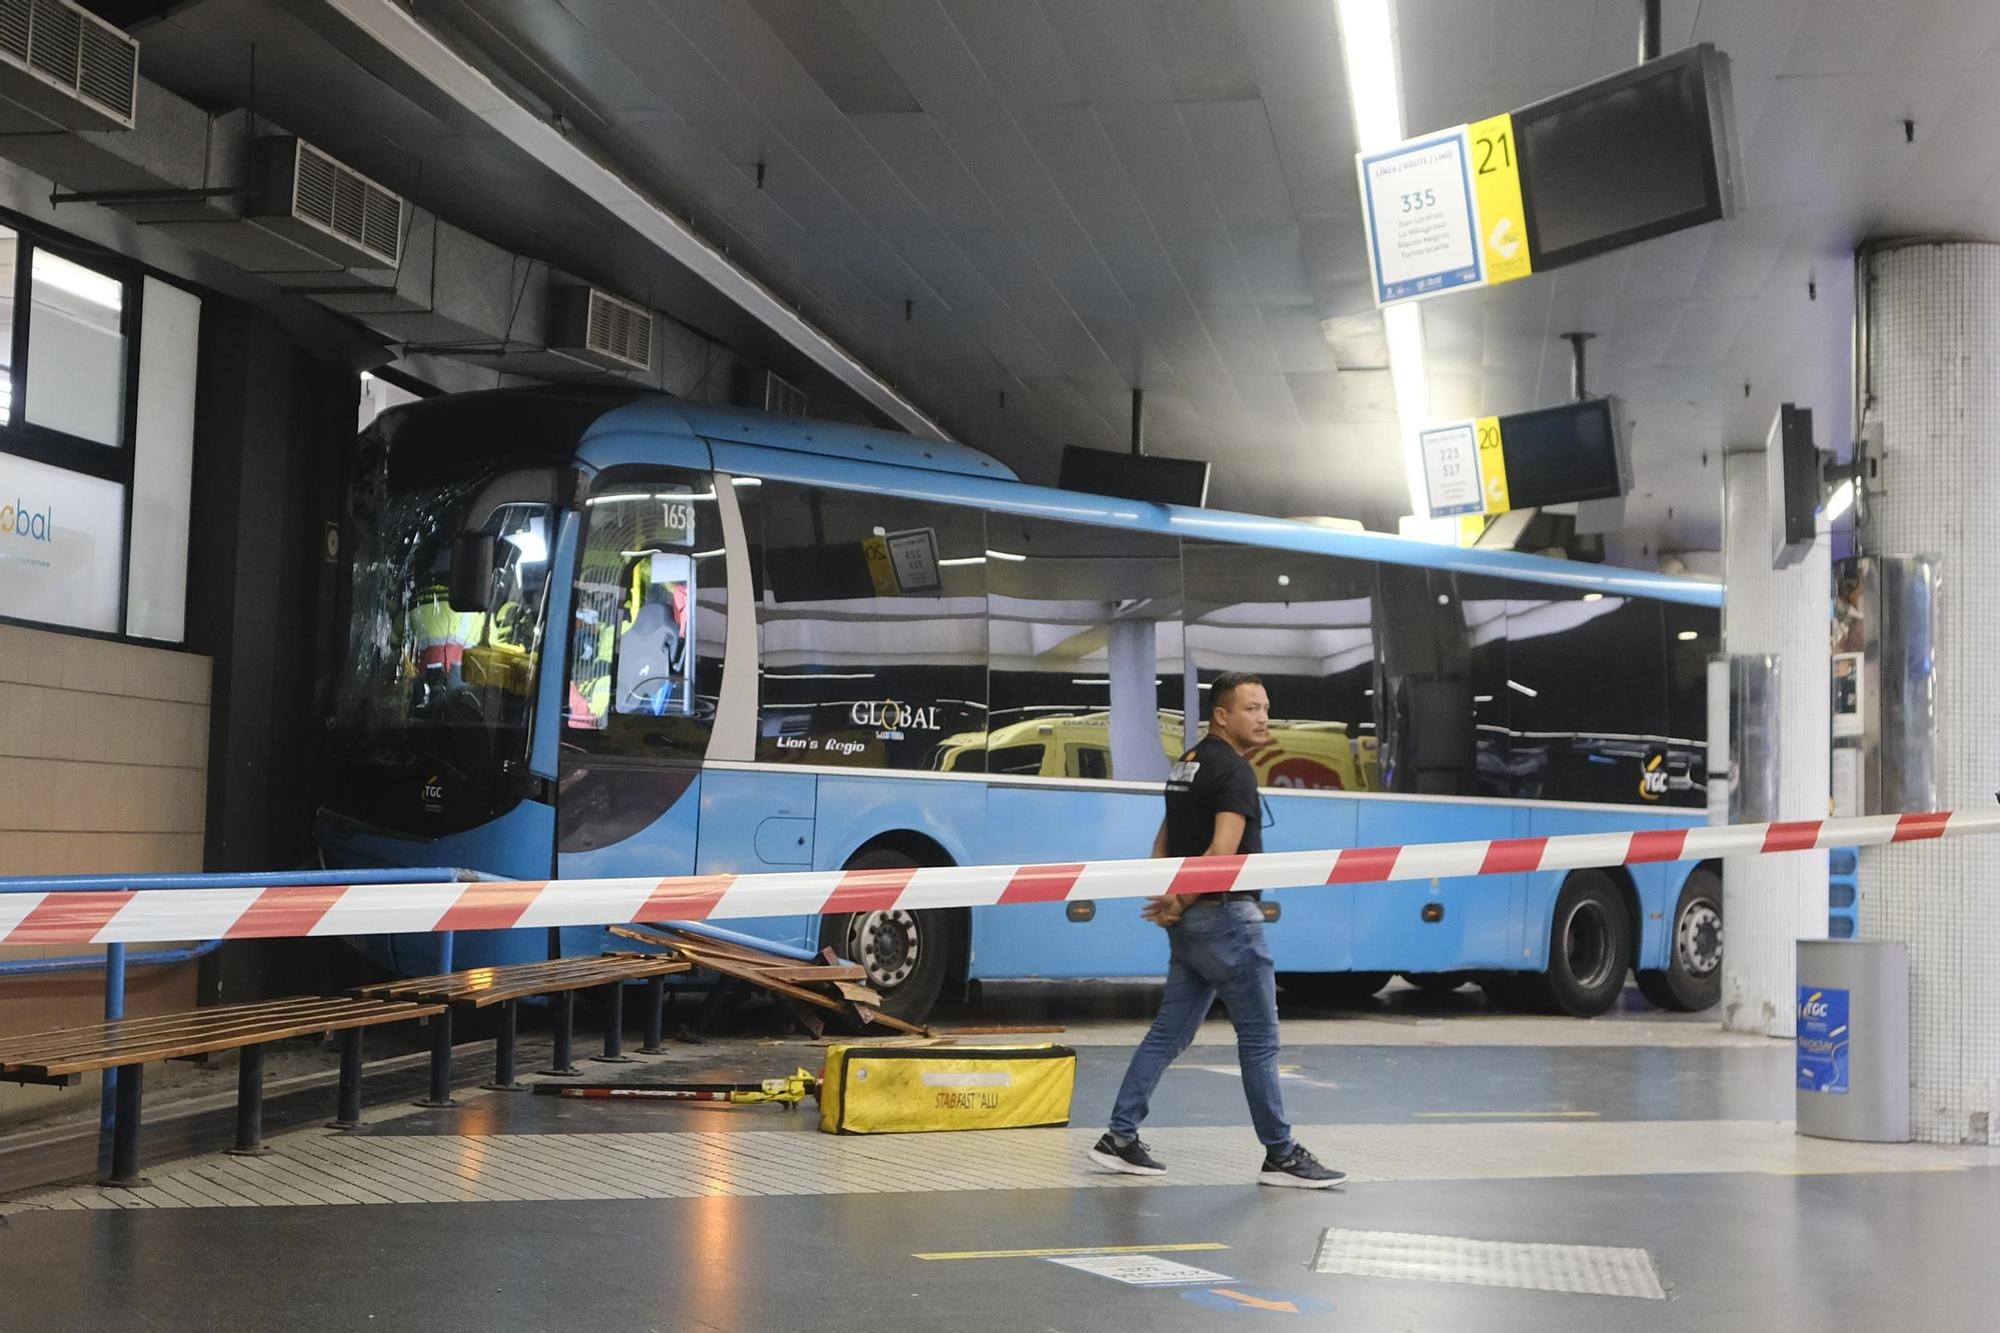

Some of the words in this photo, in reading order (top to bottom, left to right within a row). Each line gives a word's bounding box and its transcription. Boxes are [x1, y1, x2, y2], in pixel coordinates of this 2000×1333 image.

[1403, 157, 1428, 170] ROUTE
[1476, 132, 1510, 175] 21
[1400, 188, 1437, 213] 335
[1478, 426, 1500, 449] 20
[662, 503, 696, 529] 1658
[852, 698, 941, 731] GLOBAL
[776, 735, 819, 750] Lion's
[825, 738, 865, 756] Regio
[425, 785, 442, 798] TGC
[1645, 771, 1668, 793] TGC
[1807, 1002, 1829, 1017] TGC
[980, 1093, 999, 1109] ALU
